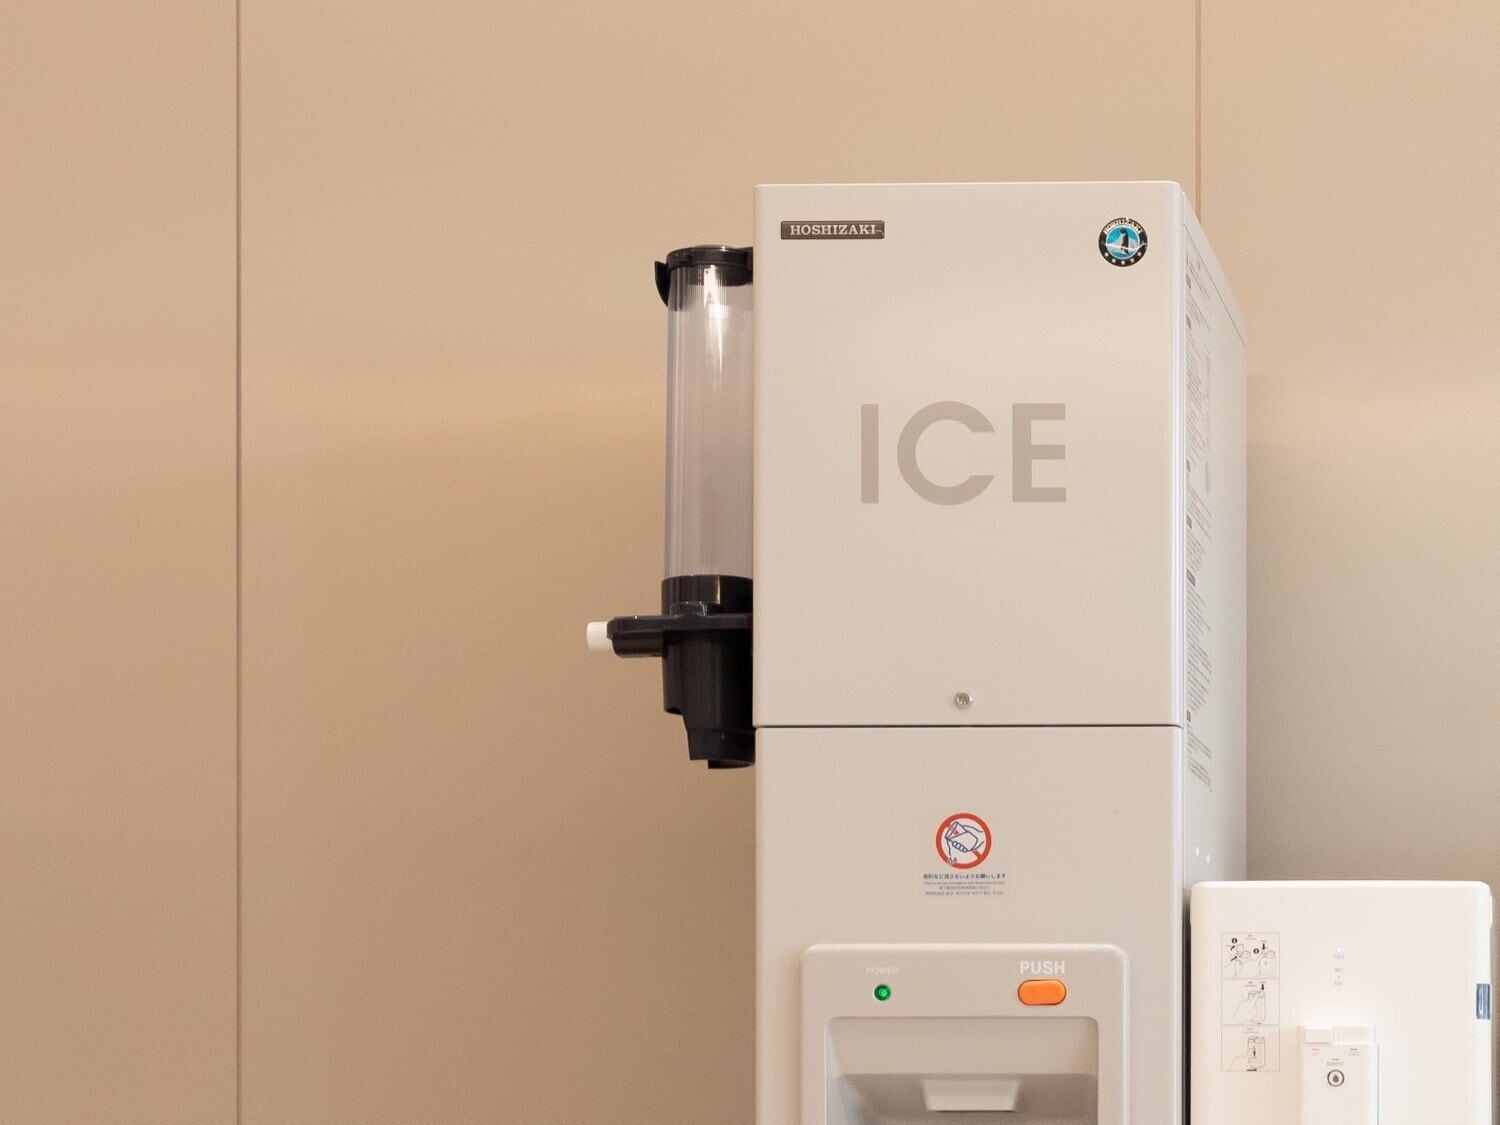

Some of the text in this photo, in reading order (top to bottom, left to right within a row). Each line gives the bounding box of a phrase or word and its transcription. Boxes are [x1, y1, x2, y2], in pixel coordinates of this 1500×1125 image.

[790, 224, 877, 236] HOSHIZAKI
[860, 400, 1067, 506] ICE
[865, 967, 899, 976] POWER
[1019, 960, 1066, 975] PUSH
